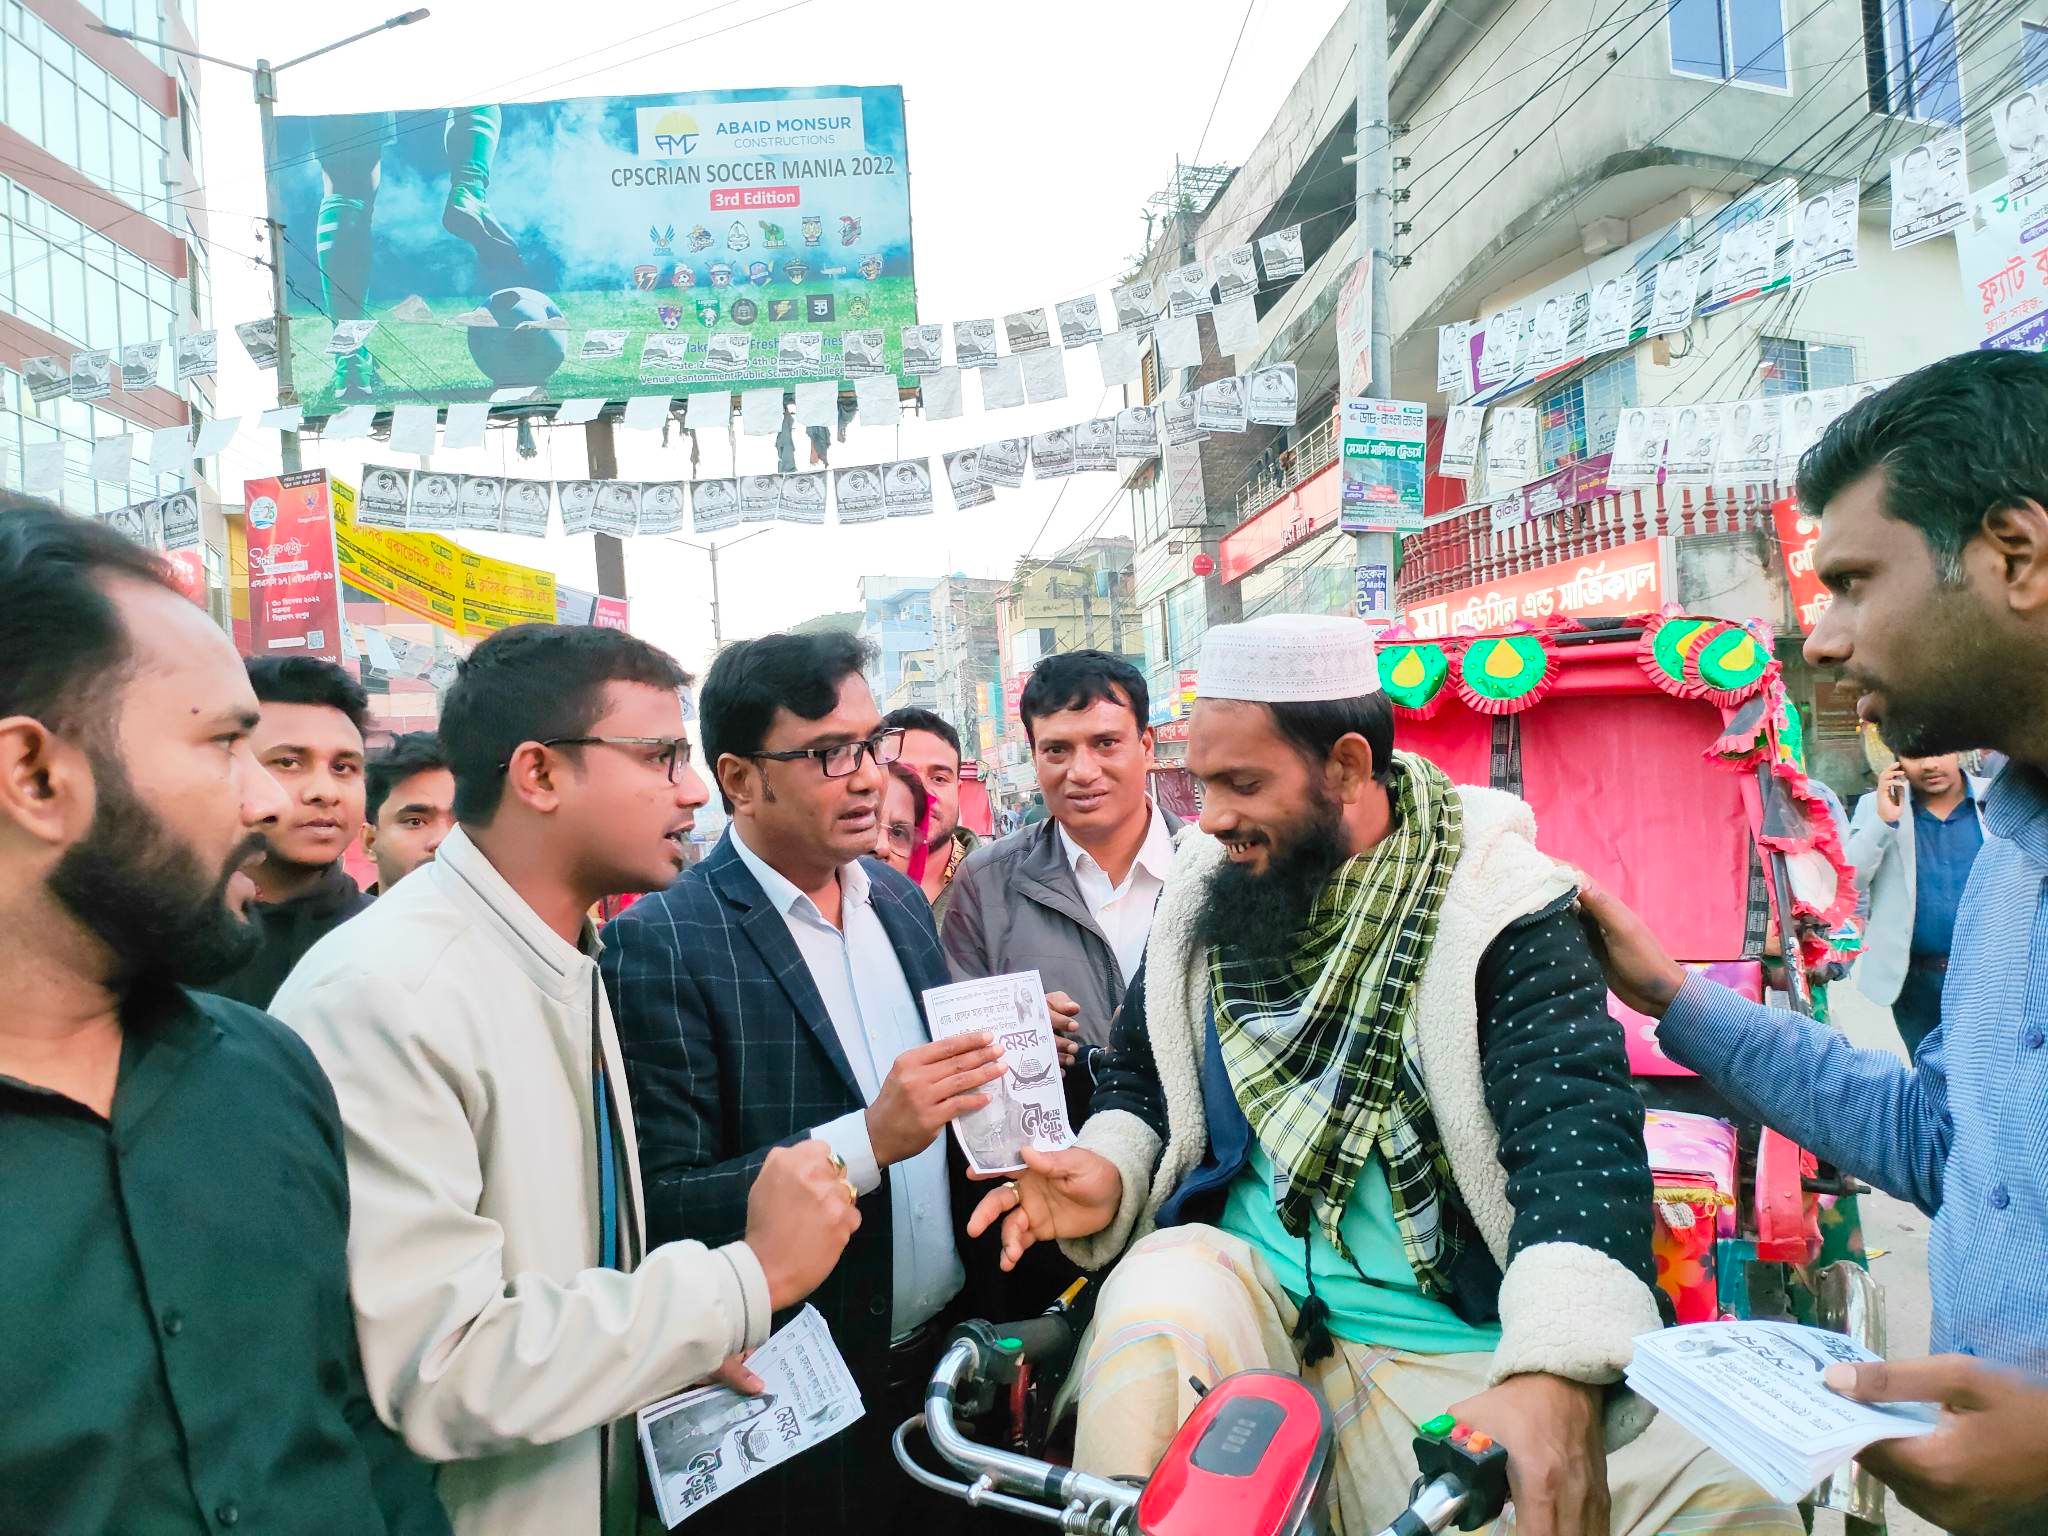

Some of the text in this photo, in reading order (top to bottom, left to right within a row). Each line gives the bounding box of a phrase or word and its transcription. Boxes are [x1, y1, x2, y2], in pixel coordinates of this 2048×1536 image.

[716, 117, 852, 135] ABAID MONSUR
[734, 135, 836, 149] CONSTRUCTIONS
[611, 155, 895, 187] CPSCRIAN SOCCER MANIA 2022
[714, 189, 796, 207] 3rd Edition
[641, 374, 674, 384] Venue:
[676, 372, 734, 382] Cantonment
[737, 369, 765, 379] Public
[1409, 602, 1447, 638] মা
[1452, 591, 1517, 634] মেডিসিন
[1521, 587, 1554, 619] এন্ড
[1557, 560, 1656, 611] সার্জিক্যাল
[999, 1030, 1039, 1050] মেয়র
[774, 1406, 801, 1441] মেয়র
